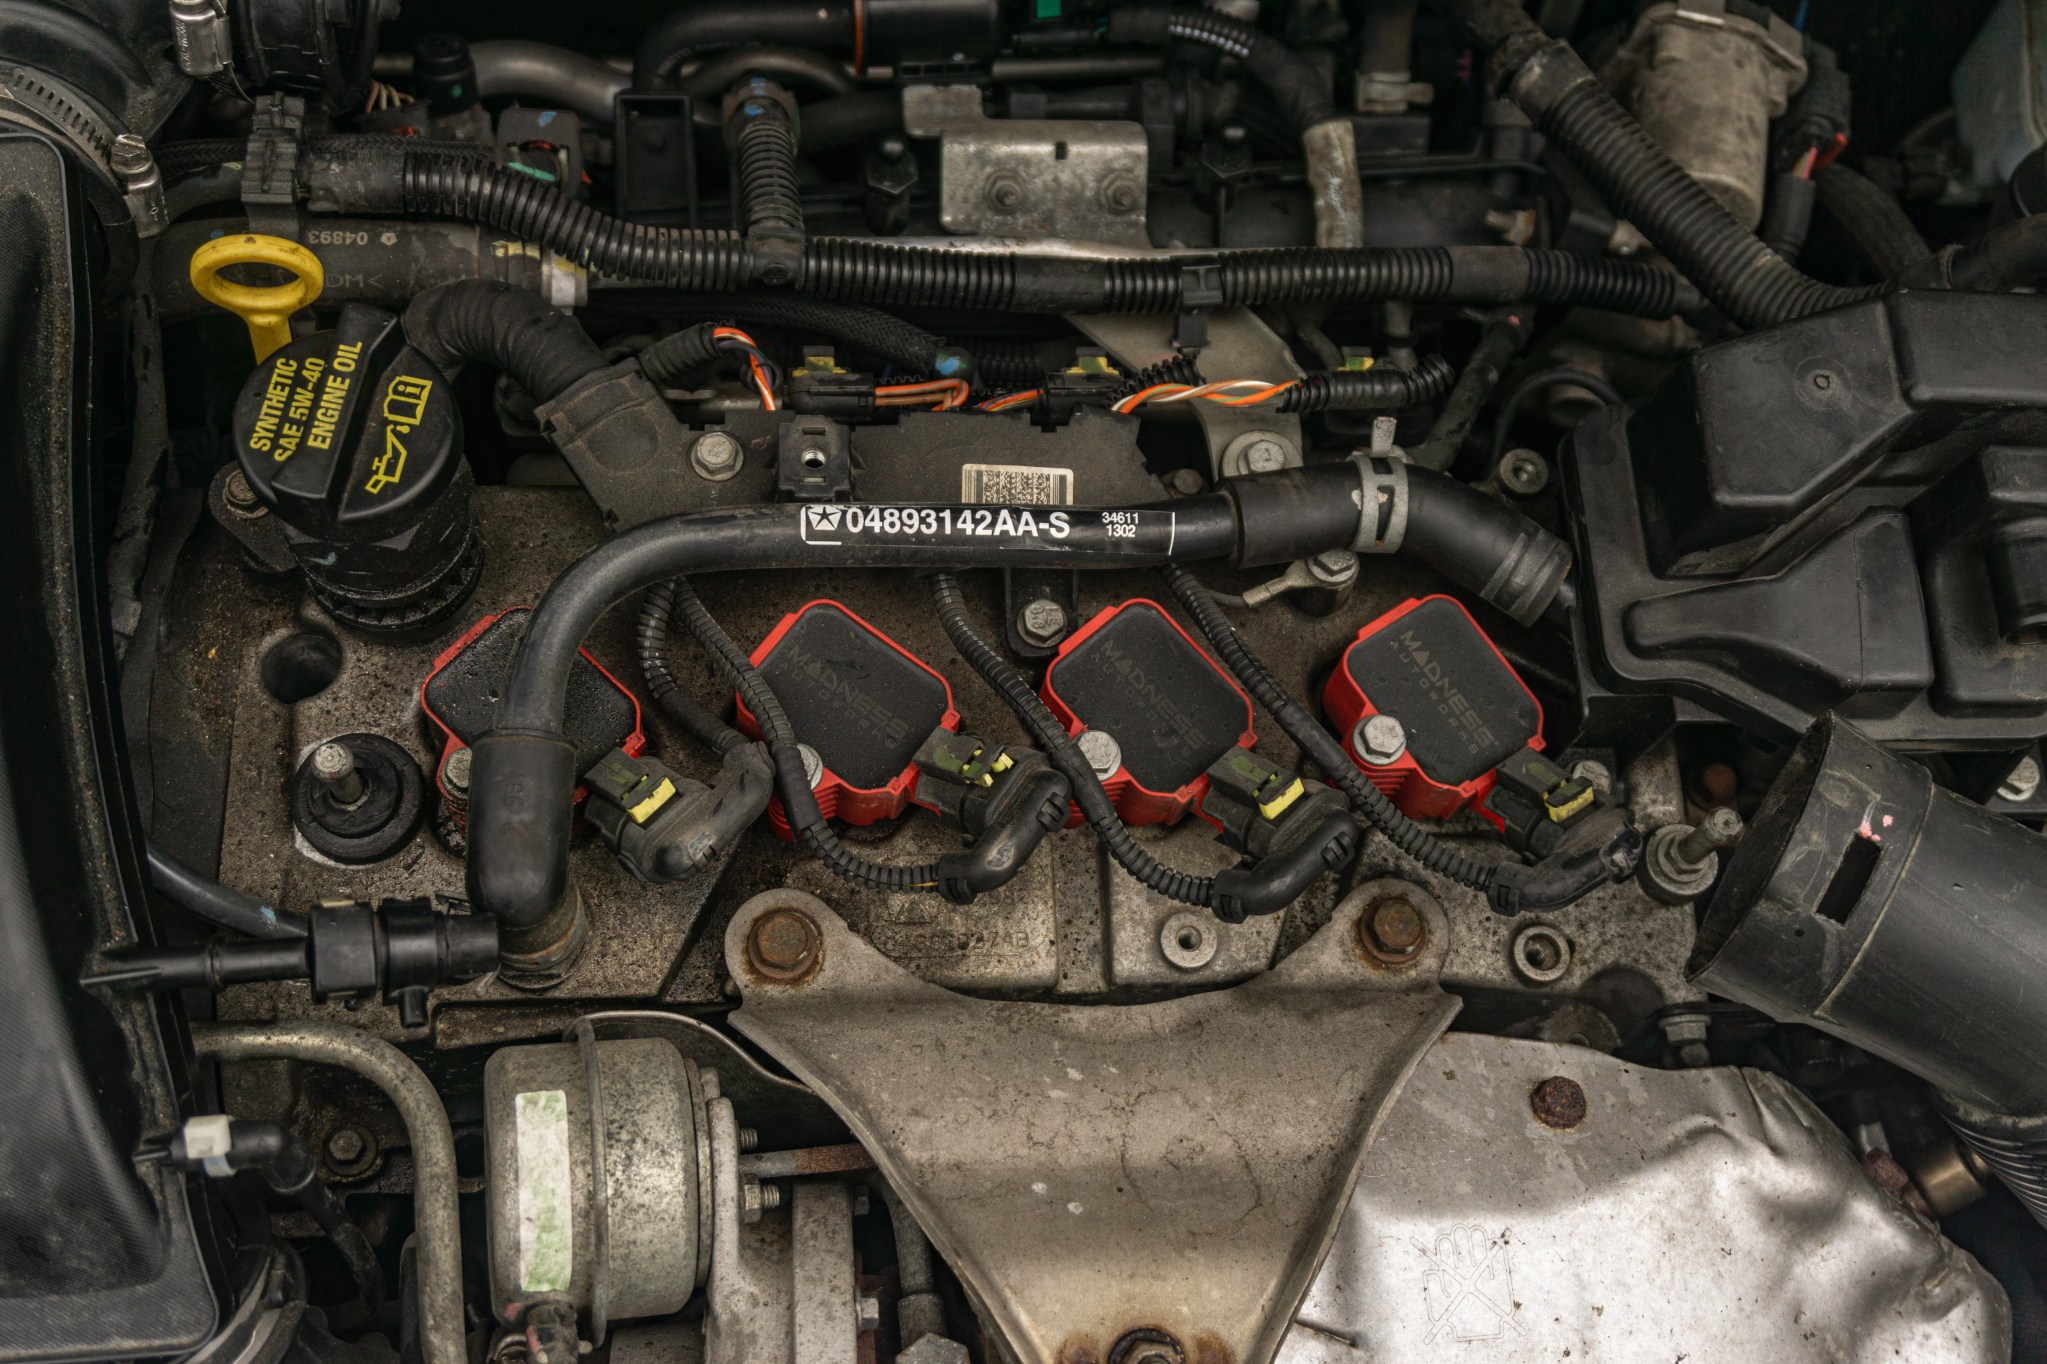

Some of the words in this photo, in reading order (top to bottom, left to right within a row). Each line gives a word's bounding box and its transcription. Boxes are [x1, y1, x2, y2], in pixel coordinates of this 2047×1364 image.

[250, 358, 298, 451] SYNTHETIC
[274, 423, 303, 462] SAE
[289, 357, 326, 422] 5W-40
[307, 375, 350, 450] ENGINE
[333, 341, 363, 373] OIL
[846, 508, 1071, 538] 04893142AA-S
[1102, 511, 1139, 525] 34611
[1106, 524, 1136, 538] 1302
[1100, 640, 1209, 750] MADNESS
[1400, 630, 1497, 748] MADNESS
